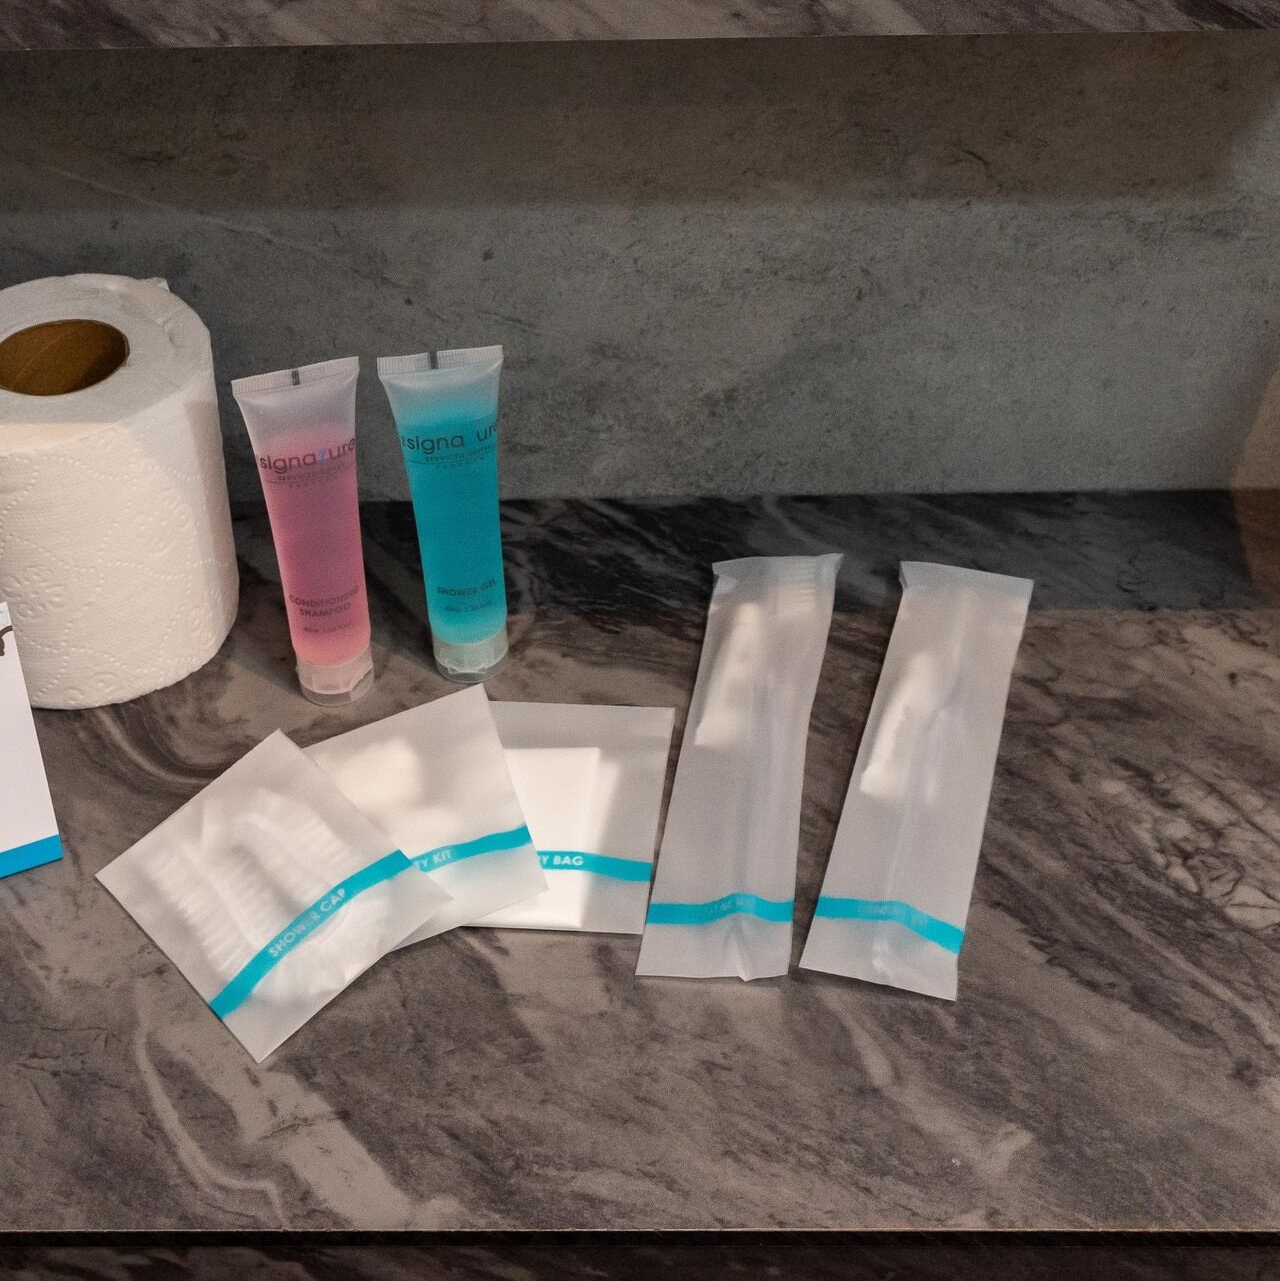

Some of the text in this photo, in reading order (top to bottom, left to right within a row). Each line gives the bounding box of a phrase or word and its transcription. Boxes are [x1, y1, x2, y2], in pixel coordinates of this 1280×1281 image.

[432, 848, 453, 864] KIT
[553, 855, 584, 866] BAG
[320, 888, 345, 911] CAP
